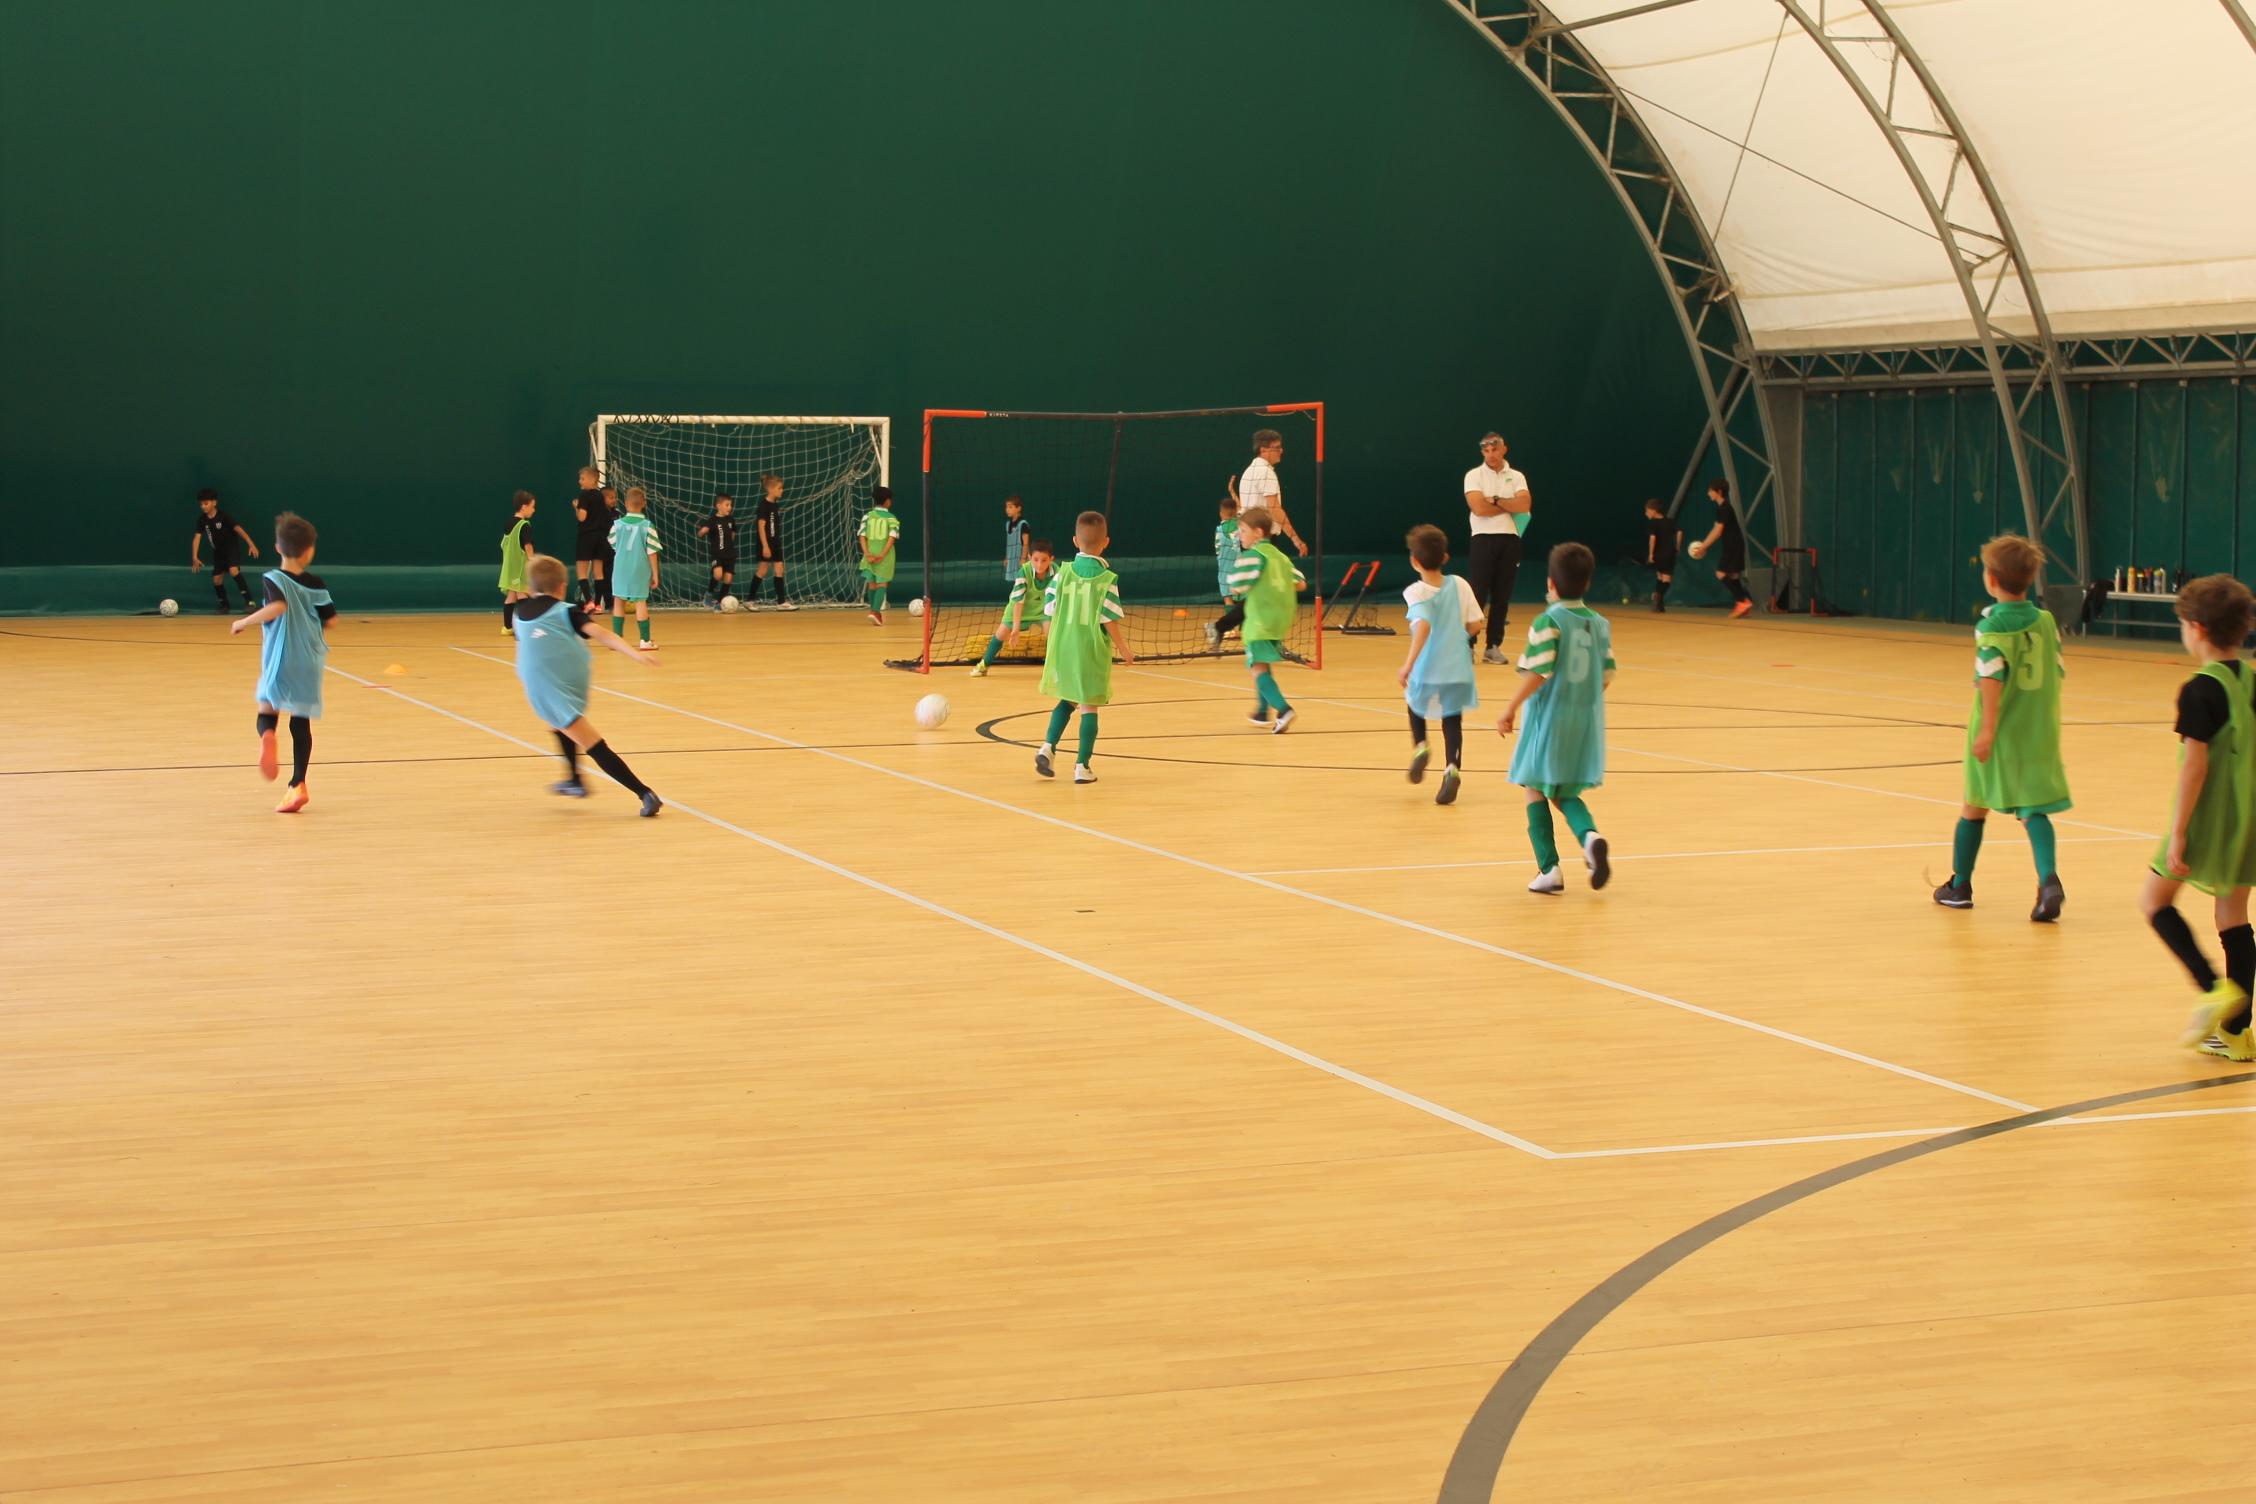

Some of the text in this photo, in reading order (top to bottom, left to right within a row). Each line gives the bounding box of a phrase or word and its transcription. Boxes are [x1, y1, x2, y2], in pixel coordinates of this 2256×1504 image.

[625, 525, 639, 551] 7
[868, 518, 887, 540] 10
[1062, 581, 1091, 625] 11
[1567, 628, 1592, 682] 6
[2016, 631, 2044, 691] 3
